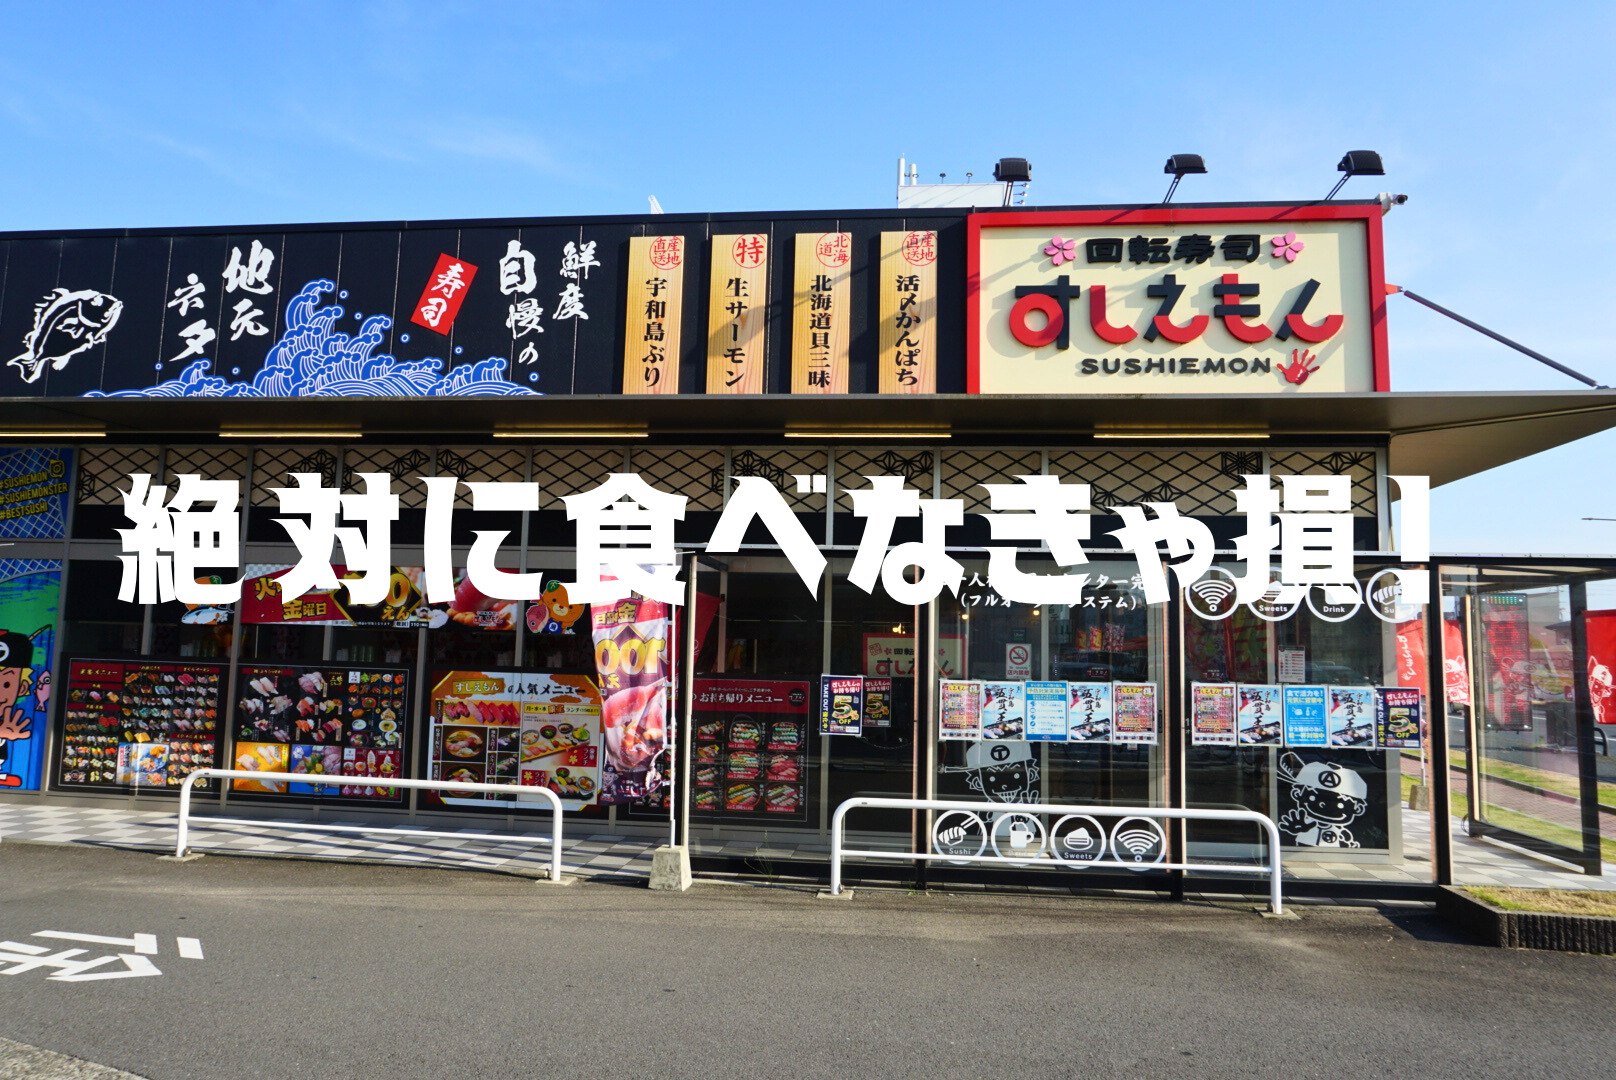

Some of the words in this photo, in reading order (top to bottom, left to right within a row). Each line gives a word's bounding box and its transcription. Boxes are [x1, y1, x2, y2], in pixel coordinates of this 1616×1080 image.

[736, 237, 765, 265] 特
[819, 235, 849, 263] 北海道
[1086, 234, 1261, 264] 回転寿司
[222, 239, 275, 341] 地元
[421, 263, 466, 327] 寿司
[1009, 273, 1344, 350] すしえもん
[641, 277, 668, 387] 宇和島ぶり
[723, 277, 750, 387] 生サーモン
[1081, 357, 1271, 374] SUSHIEMON
[1323, 605, 1345, 613] Drink
[1064, 852, 1092, 860] Sweets
